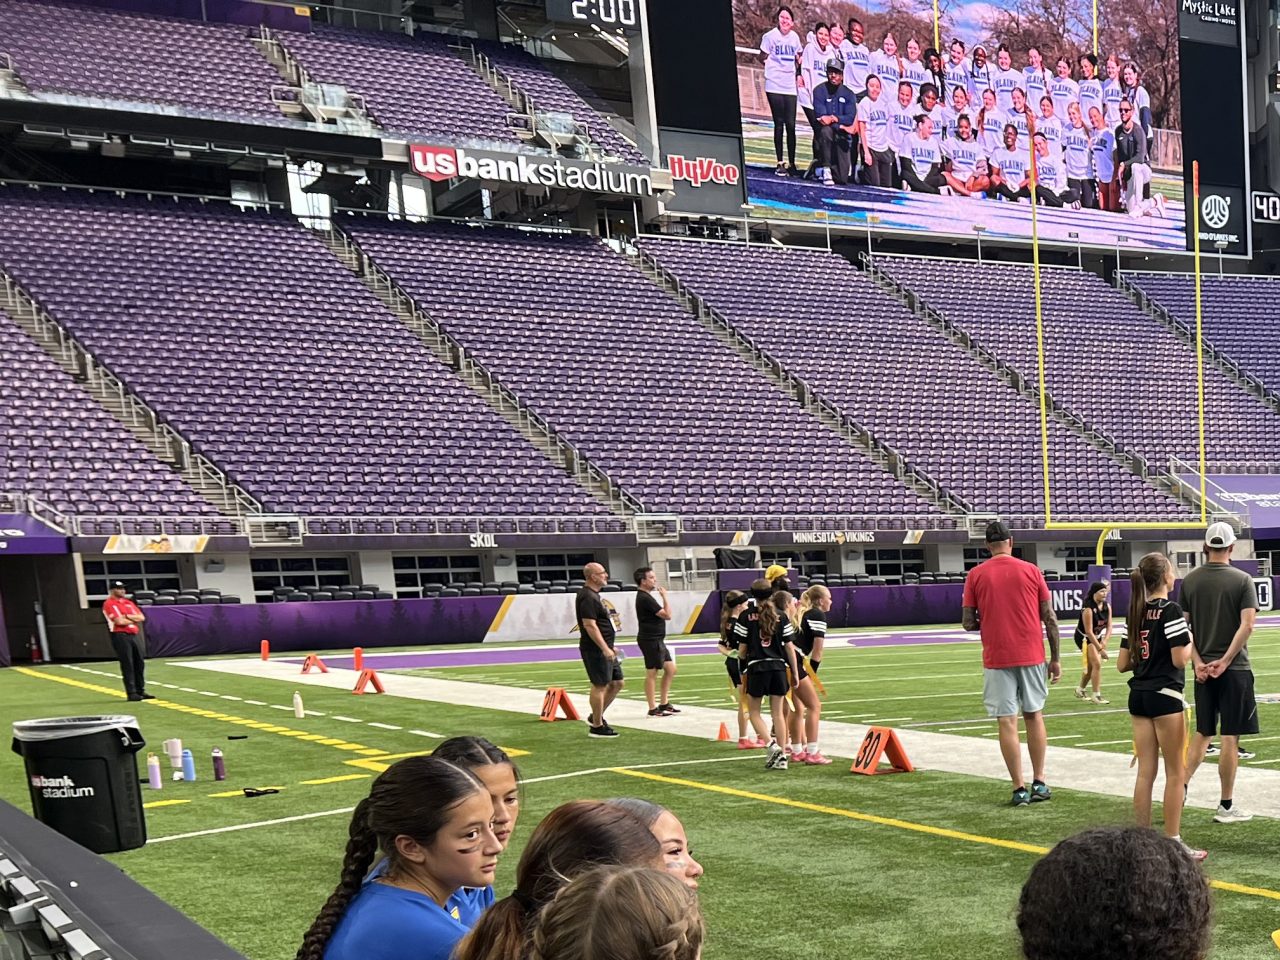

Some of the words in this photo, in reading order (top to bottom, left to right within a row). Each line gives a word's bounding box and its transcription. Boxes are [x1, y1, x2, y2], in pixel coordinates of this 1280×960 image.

[1255, 195, 1280, 221] 40
[469, 533, 499, 548] SKOL
[793, 531, 837, 543] MINNESOTA
[845, 531, 875, 542] VIKINGS
[1139, 629, 1150, 660] 5
[541, 688, 557, 718] 20
[854, 730, 881, 770] 30
[42, 786, 94, 798] stadium
